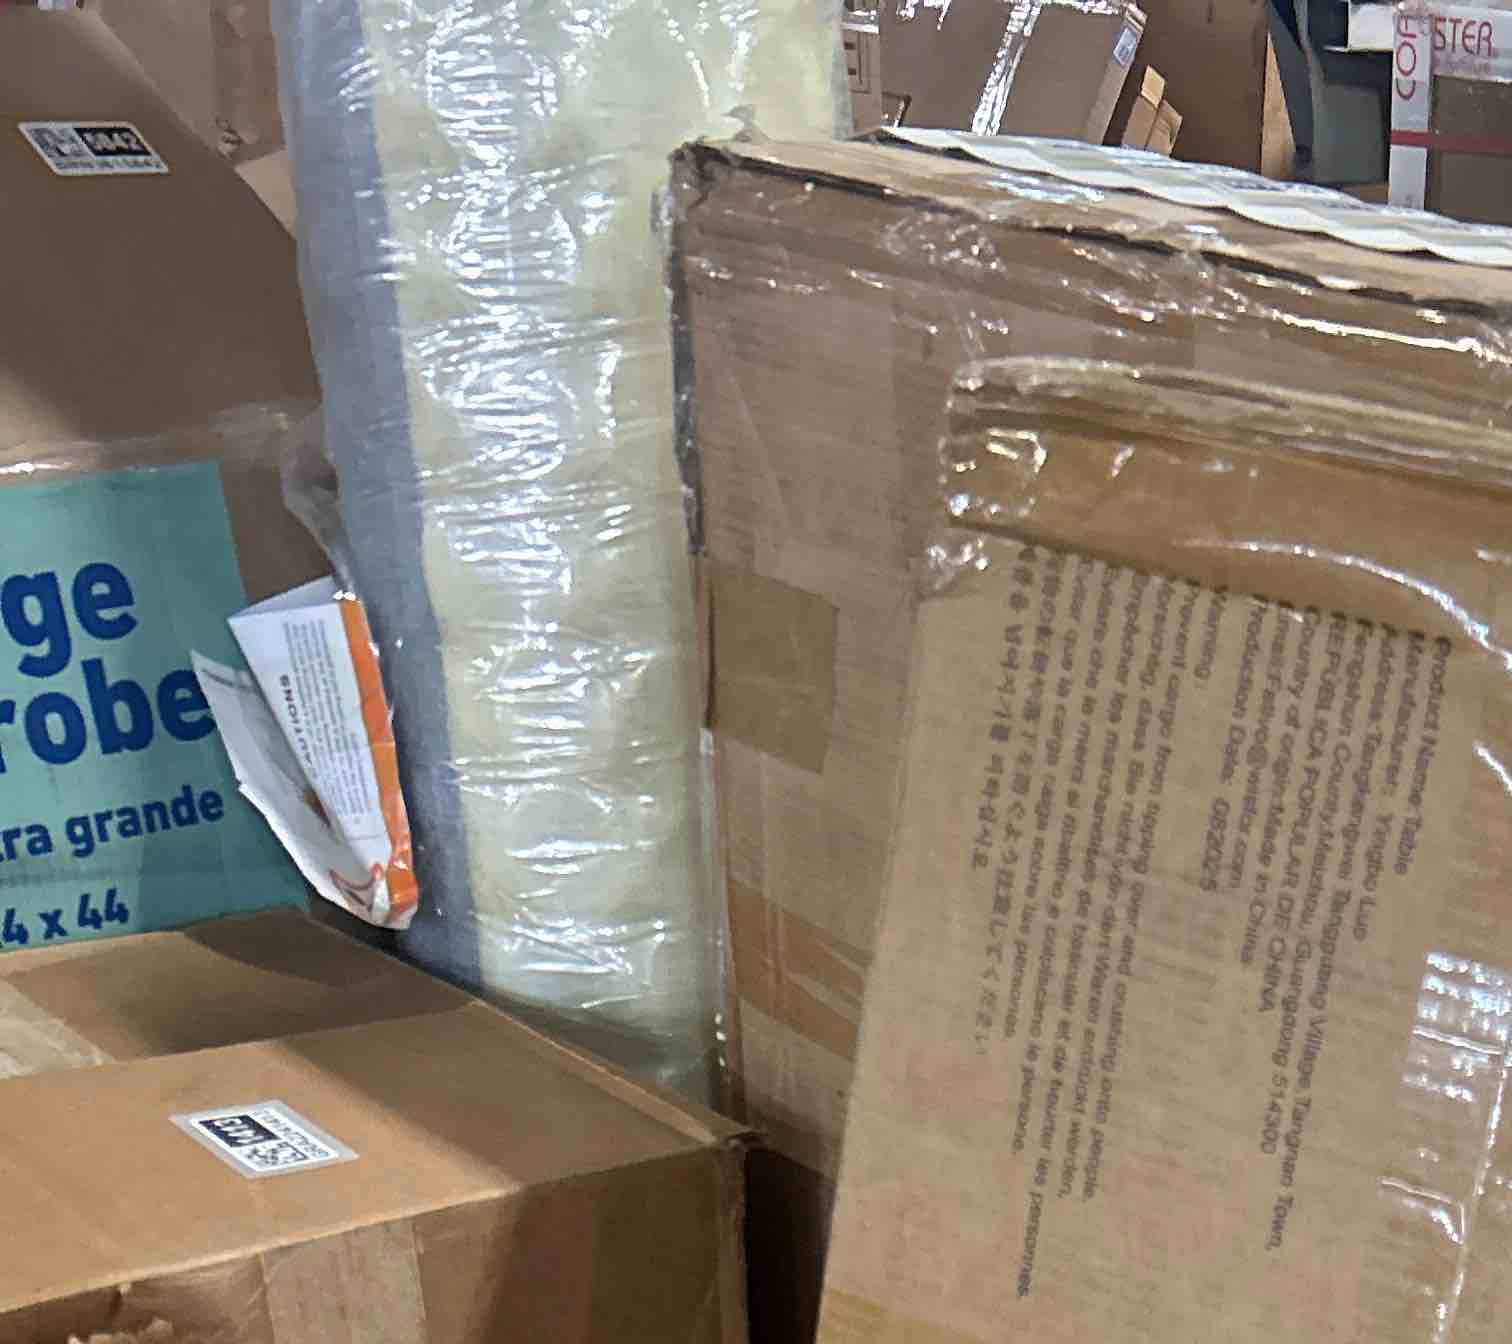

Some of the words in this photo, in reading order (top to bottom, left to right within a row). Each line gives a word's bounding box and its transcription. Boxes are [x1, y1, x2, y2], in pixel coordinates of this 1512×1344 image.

[1418, 635, 1455, 731] Product
[1145, 743, 1171, 796] from
[0, 822, 52, 861] ra
[66, 784, 224, 858] grande
[1280, 765, 1322, 891] POPULAR
[39, 909, 68, 940] x
[77, 888, 130, 930] 44
[1251, 872, 1272, 893] in
[1273, 893, 1298, 930] DE
[1115, 934, 1138, 976] and
[1238, 897, 1267, 966] China
[1257, 935, 1290, 1015] CHINA
[1254, 1074, 1289, 1155] 514300
